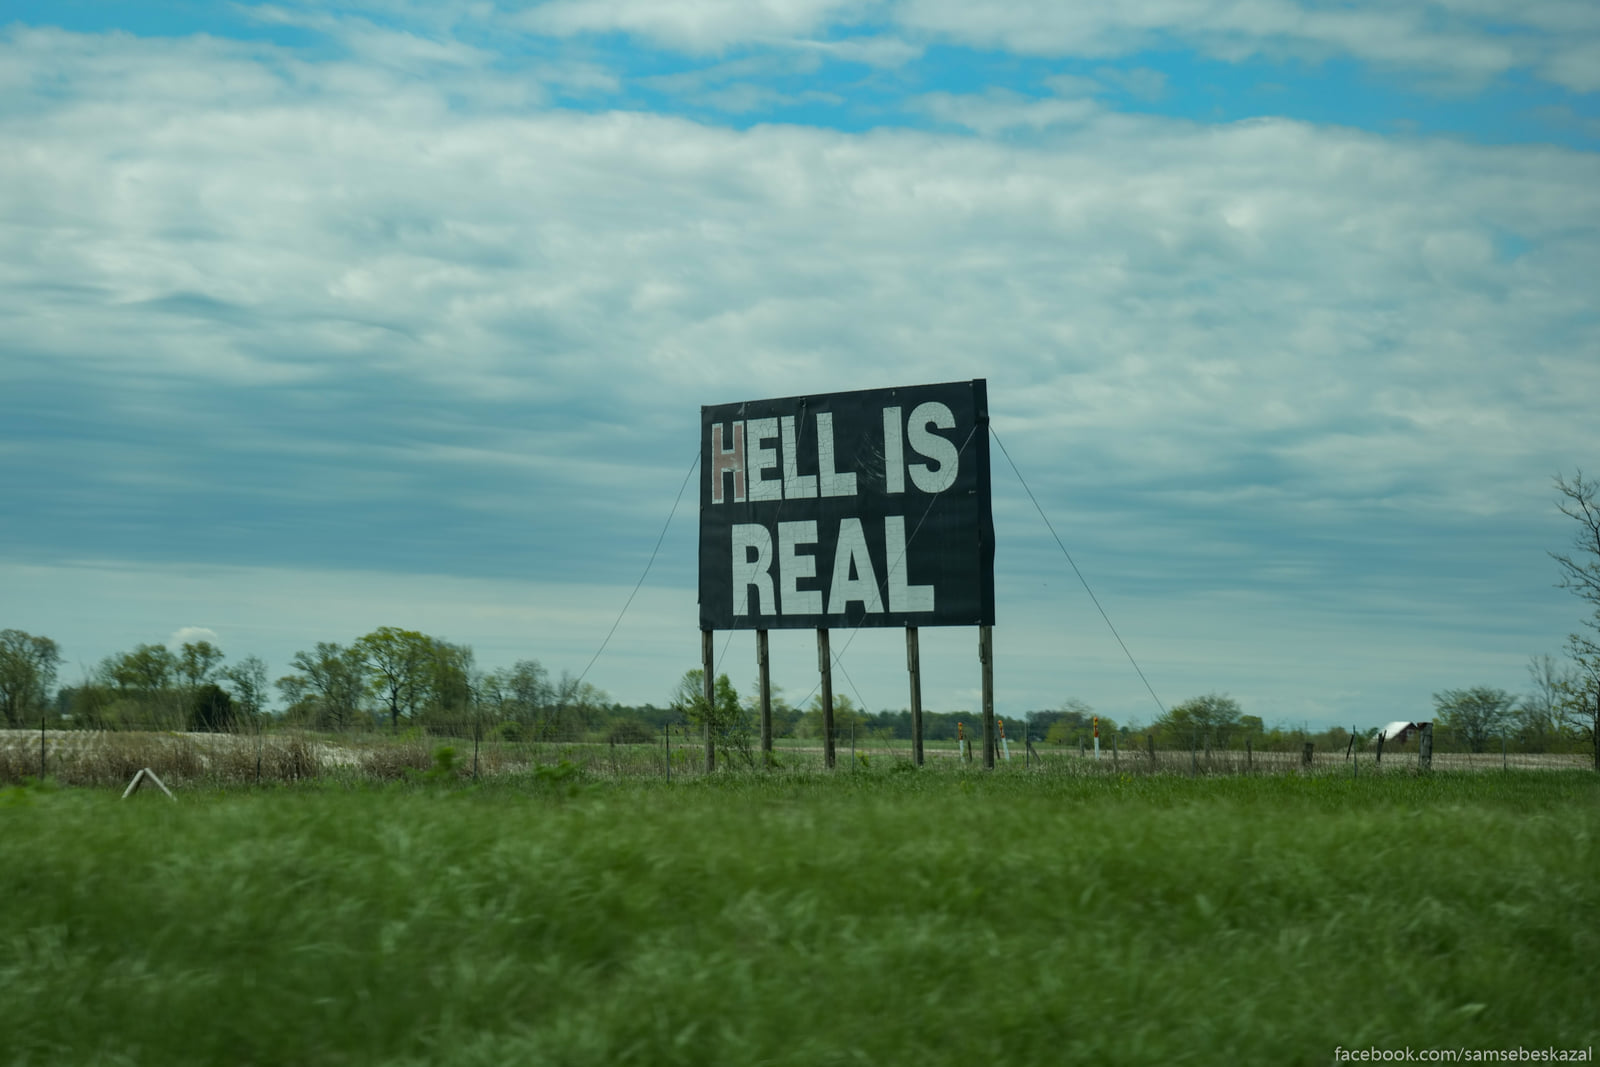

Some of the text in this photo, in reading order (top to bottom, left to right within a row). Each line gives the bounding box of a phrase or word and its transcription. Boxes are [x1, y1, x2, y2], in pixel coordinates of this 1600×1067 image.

[711, 401, 960, 504] HELL IS
[731, 515, 935, 616] REAL
